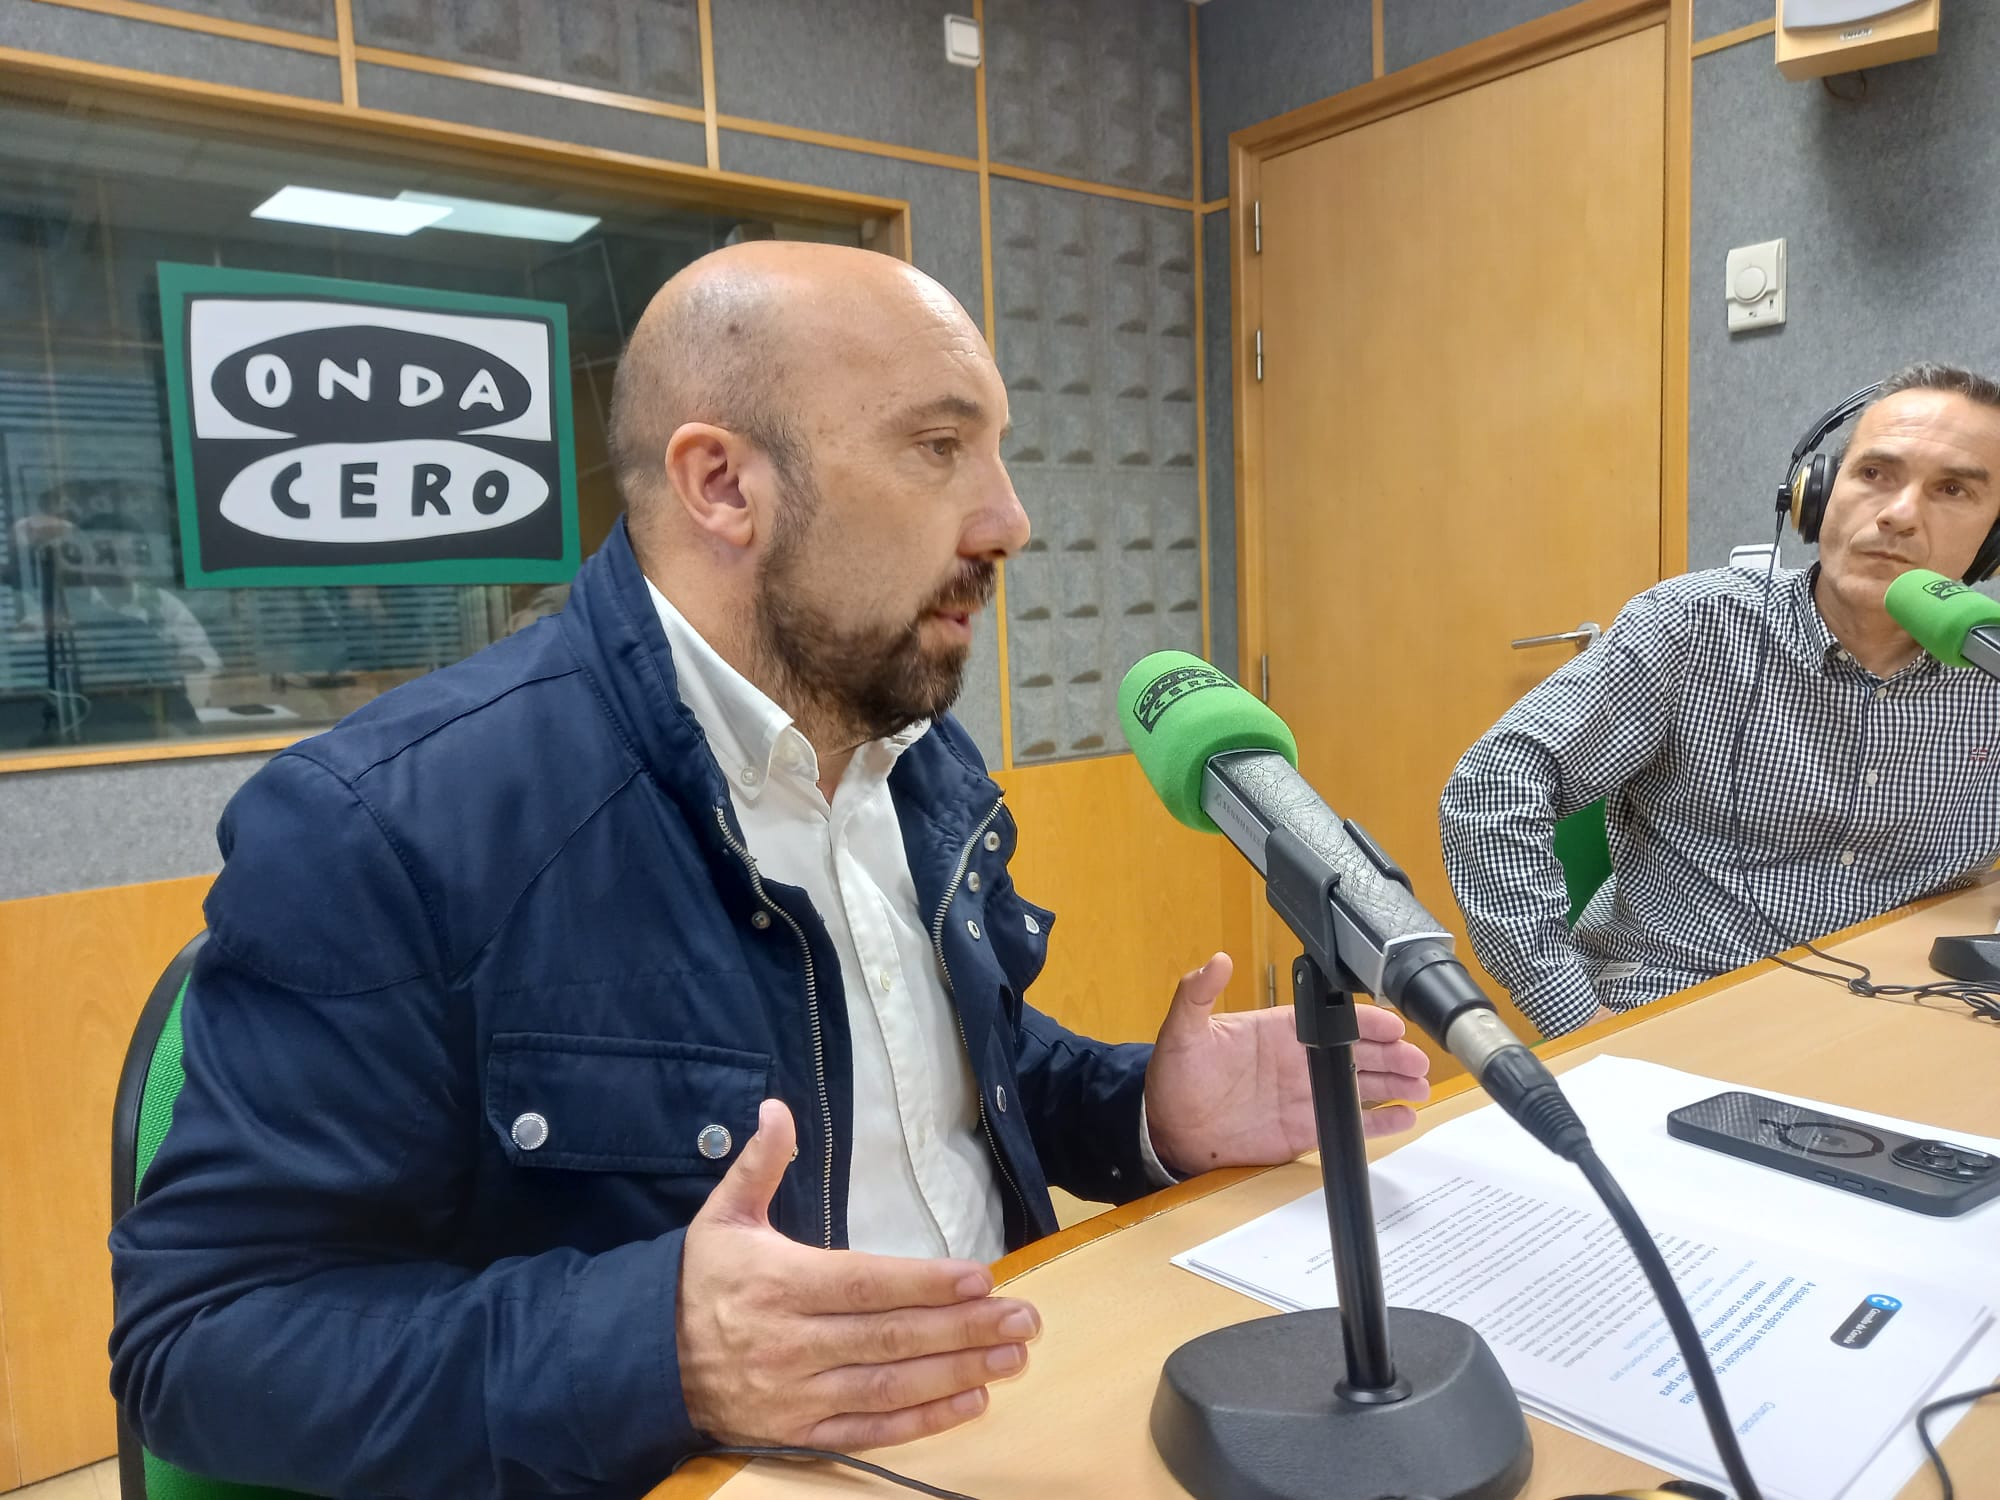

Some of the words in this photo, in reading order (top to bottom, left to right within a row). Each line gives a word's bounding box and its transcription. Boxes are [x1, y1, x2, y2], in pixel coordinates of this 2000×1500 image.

[245, 353, 505, 412] ONDA
[271, 462, 510, 519] CERO
[1154, 679, 1217, 710] CERO
[1761, 1311, 1784, 1330] acepta
